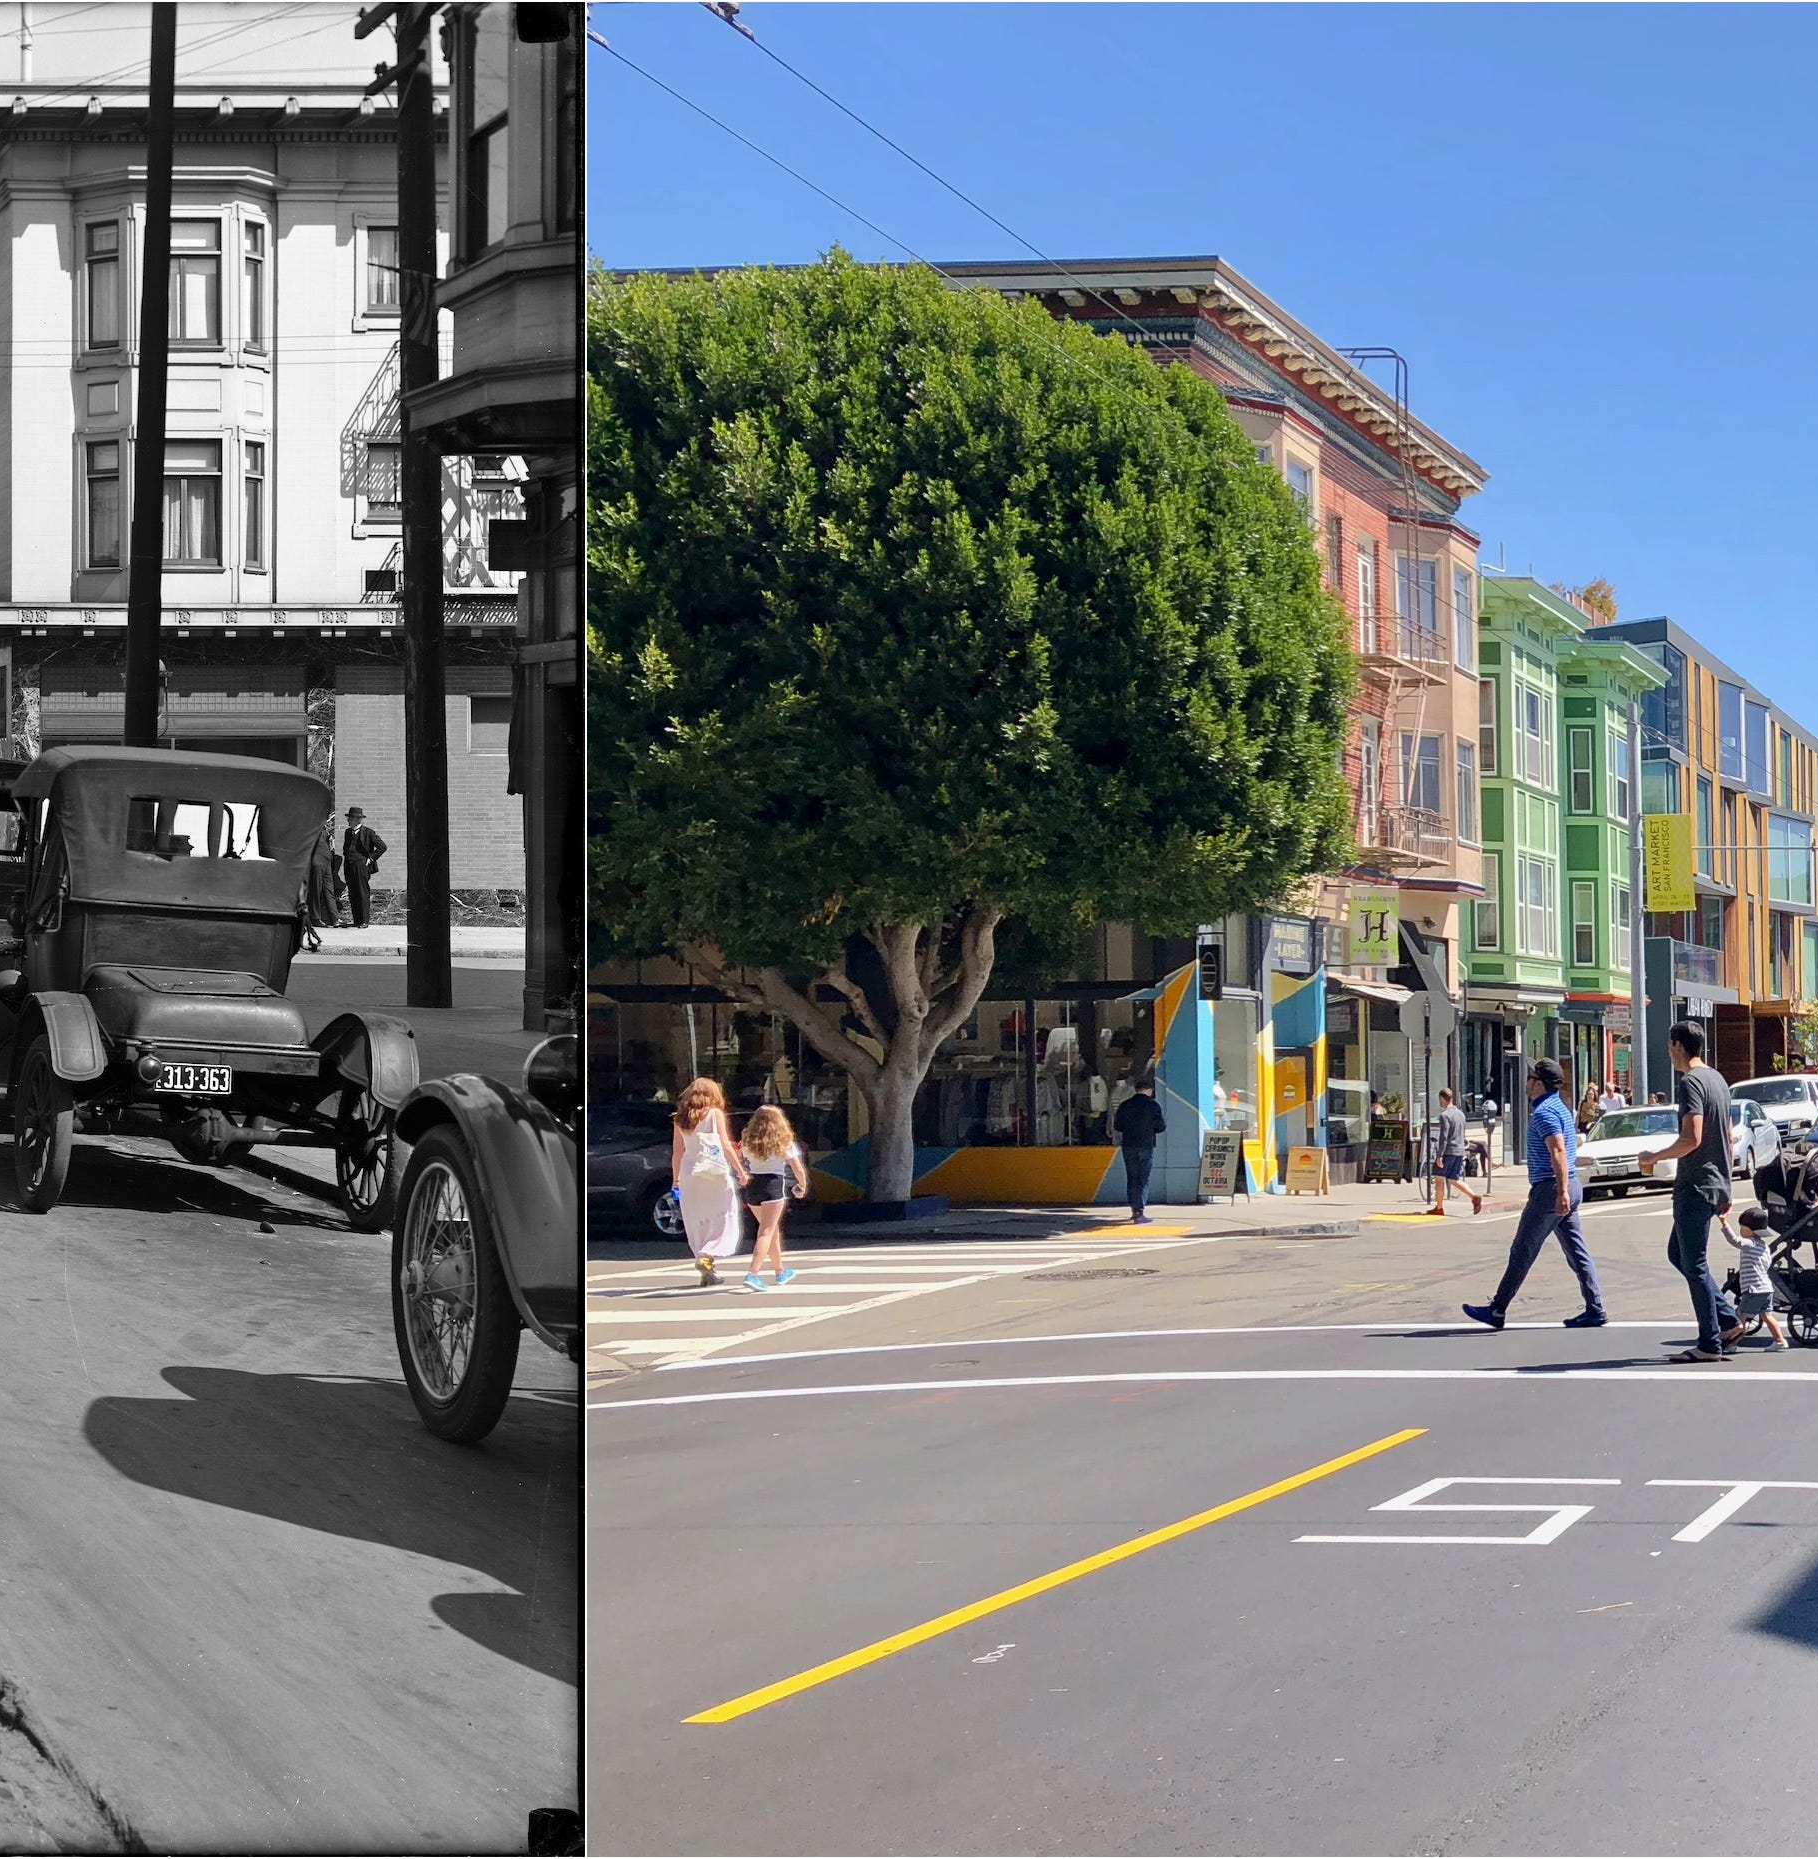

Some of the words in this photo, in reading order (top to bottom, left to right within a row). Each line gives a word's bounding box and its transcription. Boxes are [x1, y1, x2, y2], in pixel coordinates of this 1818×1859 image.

[1650, 820, 1661, 866] MARKET
[1661, 819, 1672, 872] FRANCISCO
[1652, 871, 1662, 892] ART
[1663, 876, 1672, 892] SAN
[1203, 1176, 1228, 1184] OCTAVIA
